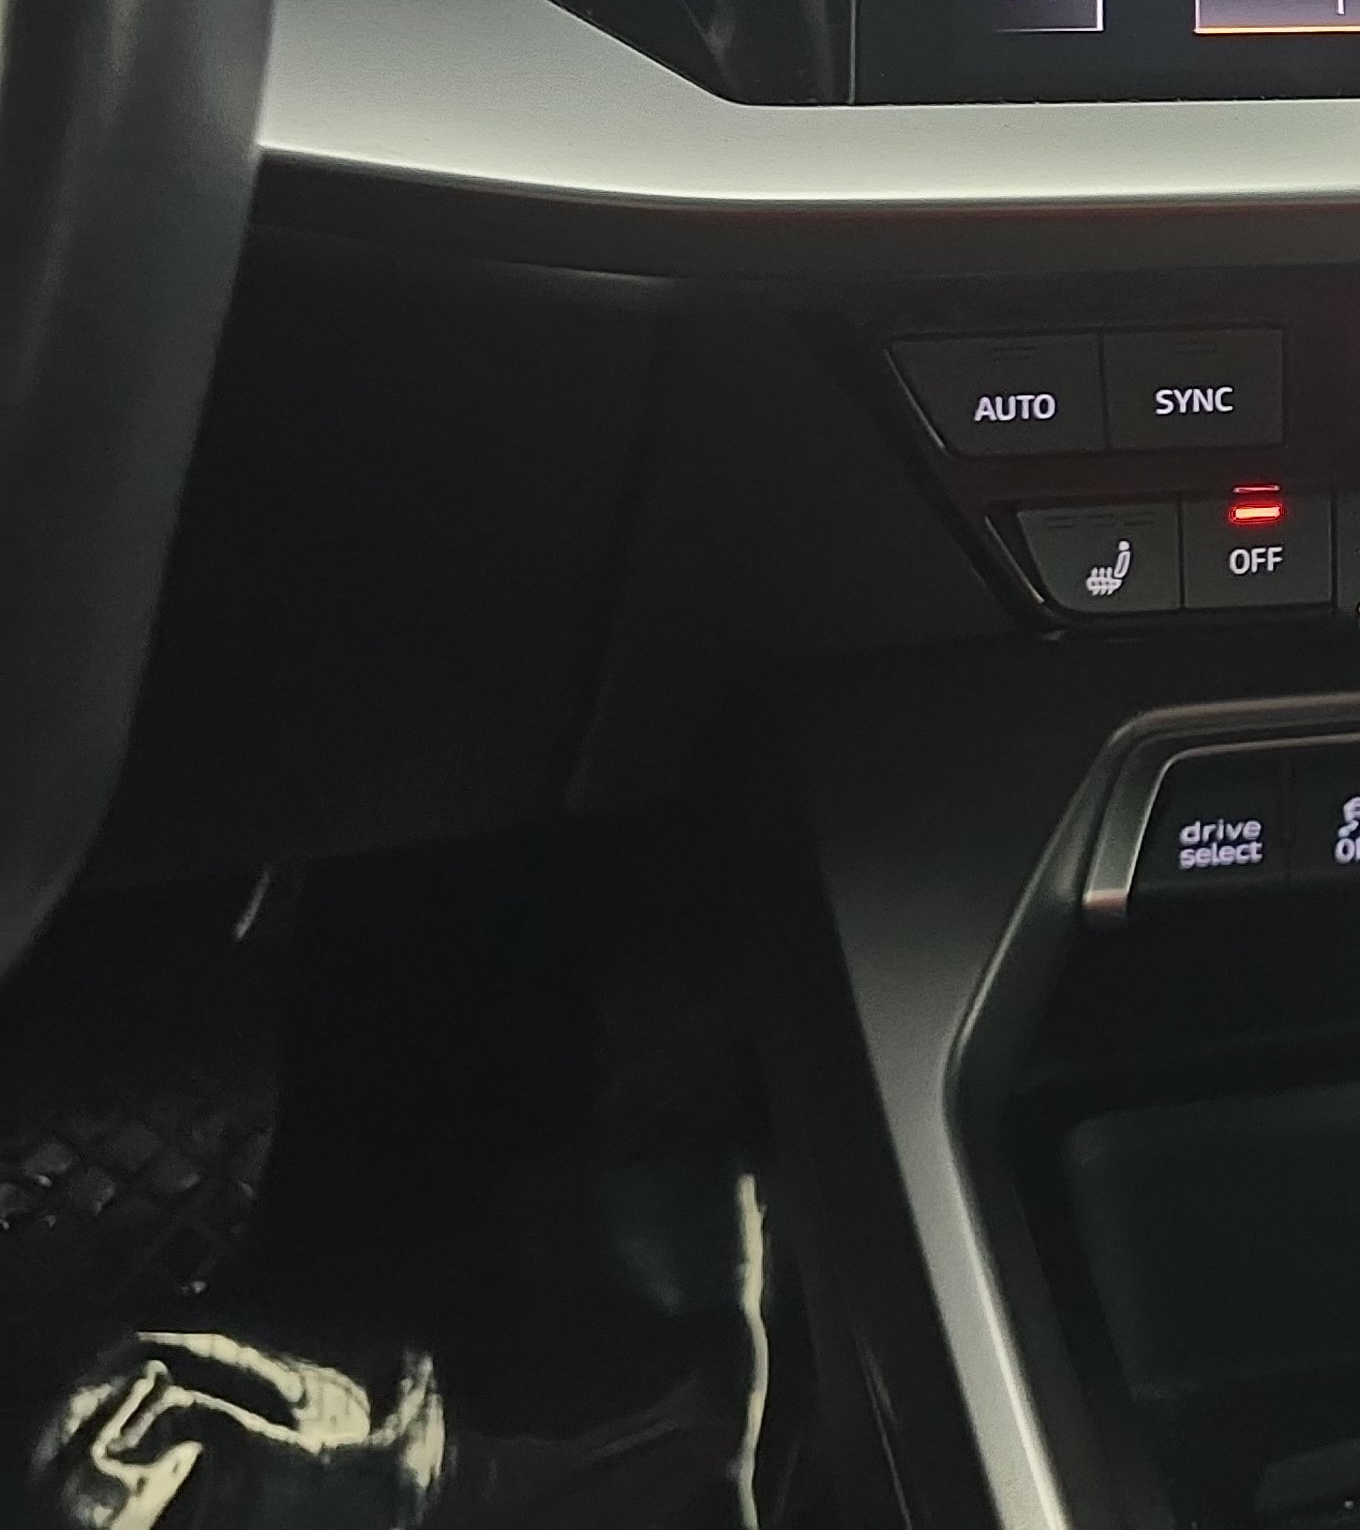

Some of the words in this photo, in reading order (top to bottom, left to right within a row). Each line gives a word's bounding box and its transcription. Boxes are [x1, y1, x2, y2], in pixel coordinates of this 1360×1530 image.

[974, 393, 1056, 422] AUTO
[1155, 386, 1233, 415] SYNC
[1229, 546, 1283, 575] OFF
[1180, 820, 1262, 844] drive
[1180, 843, 1262, 869] select
